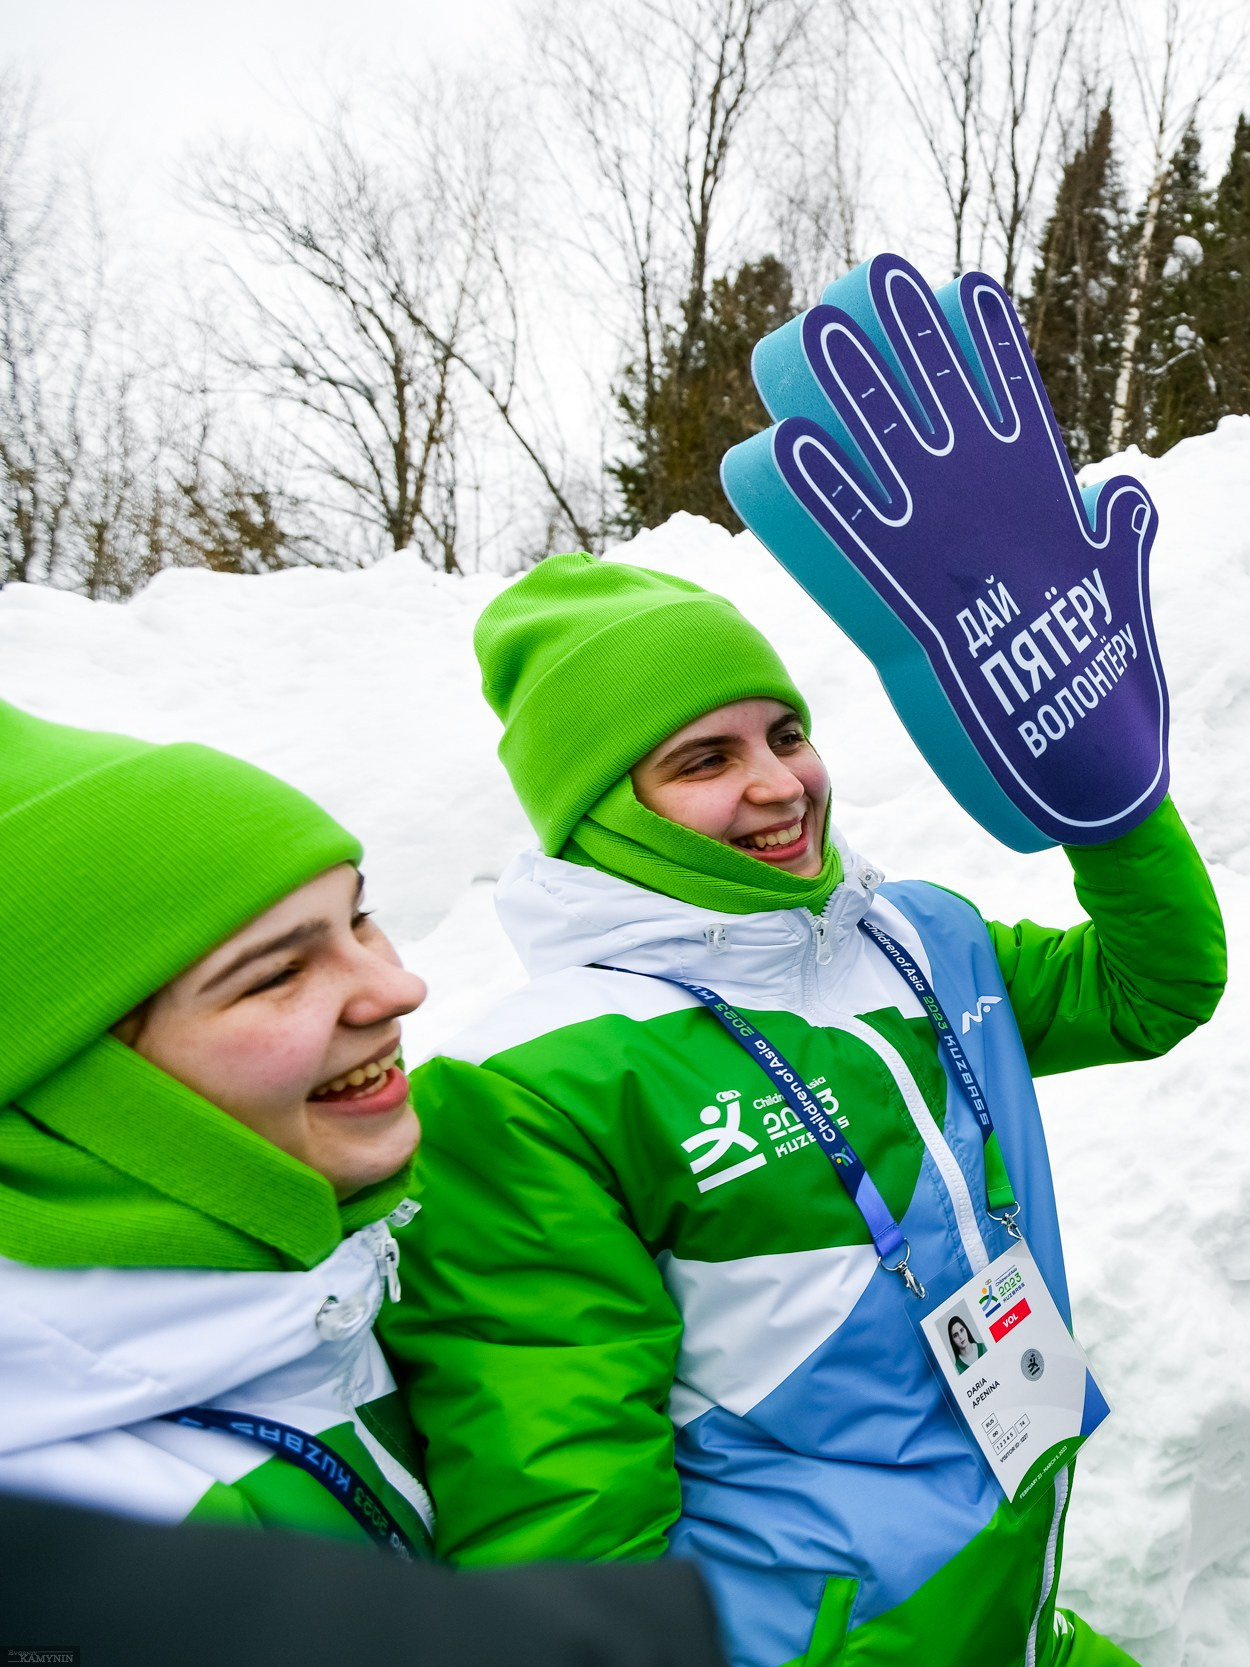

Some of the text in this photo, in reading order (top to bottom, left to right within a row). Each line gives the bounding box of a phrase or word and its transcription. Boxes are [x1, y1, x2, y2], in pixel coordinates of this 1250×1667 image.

[956, 575, 1021, 658] ДАЙ
[979, 568, 1112, 716] ПЯТЁРУ
[1017, 623, 1138, 758] ВОЛОНТЁРУ
[863, 919, 990, 1126] Children of Asia 2023 KUZBASS
[714, 1003, 836, 1142] Children of Asia 2023
[753, 1093, 786, 1110] Childr
[762, 1087, 839, 1141] 203
[774, 1115, 850, 1158] KUZBS
[998, 1271, 1022, 1297] 2023
[1002, 1313, 1019, 1328] VOL
[966, 1377, 988, 1399] DARIA
[972, 1380, 1001, 1409] APENINA
[985, 1418, 995, 1429] RUS
[999, 1446, 1016, 1463] VISITOR
[1020, 1478, 1038, 1499] FEBRUARY
[1043, 1457, 1057, 1473] MARCH
